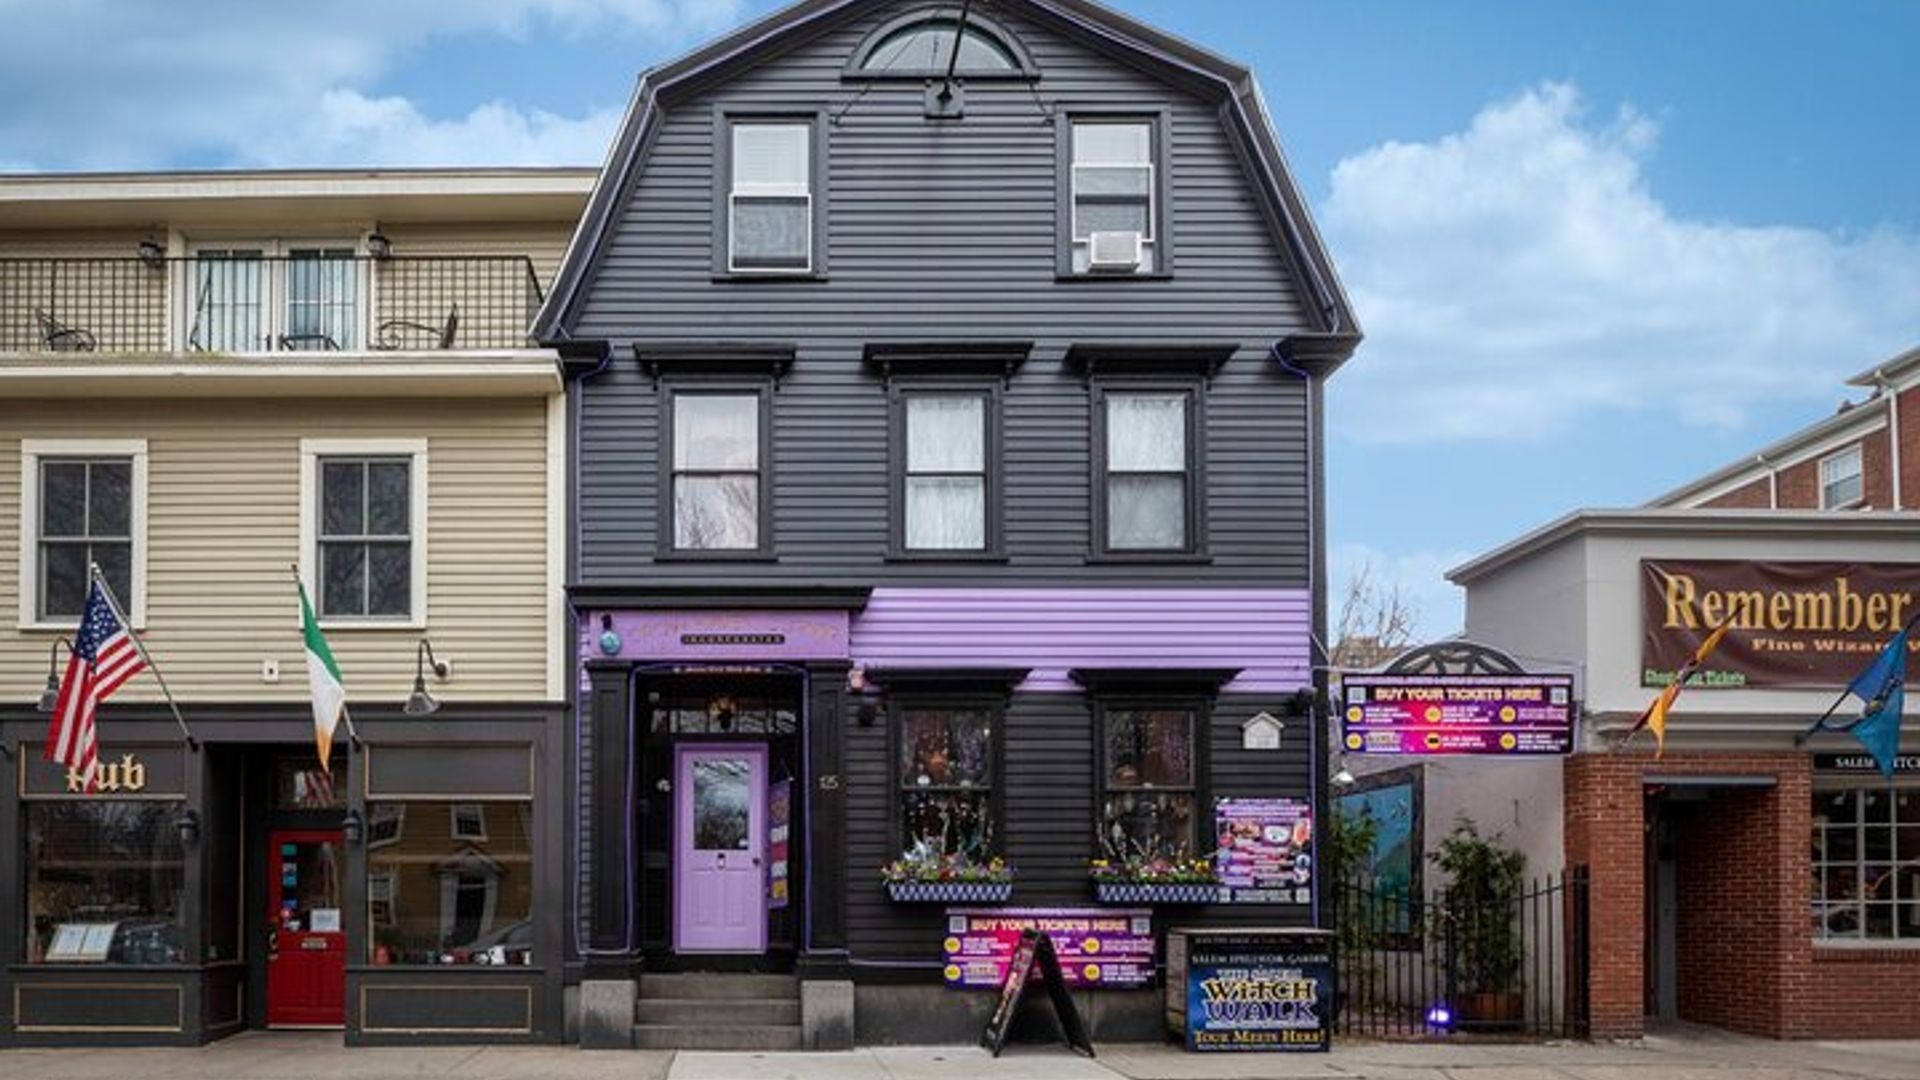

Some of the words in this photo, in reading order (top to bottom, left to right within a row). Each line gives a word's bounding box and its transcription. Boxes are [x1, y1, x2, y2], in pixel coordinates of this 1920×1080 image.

[1663, 575, 1911, 632] Remember
[1752, 639, 1805, 651] Fine
[1814, 639, 1887, 651] Wizar
[1375, 688, 1404, 701] BUY
[1405, 688, 1444, 701] YOUR
[1446, 688, 1503, 701] TICKETS
[1504, 688, 1542, 701] HERE
[1834, 757, 1875, 768] SALEM
[971, 919, 998, 931] BUY
[1037, 919, 1090, 931] TICKETS
[1092, 919, 1128, 931] HERE
[1201, 979, 1317, 1001] WITCH
[1203, 1000, 1318, 1020] WALK
